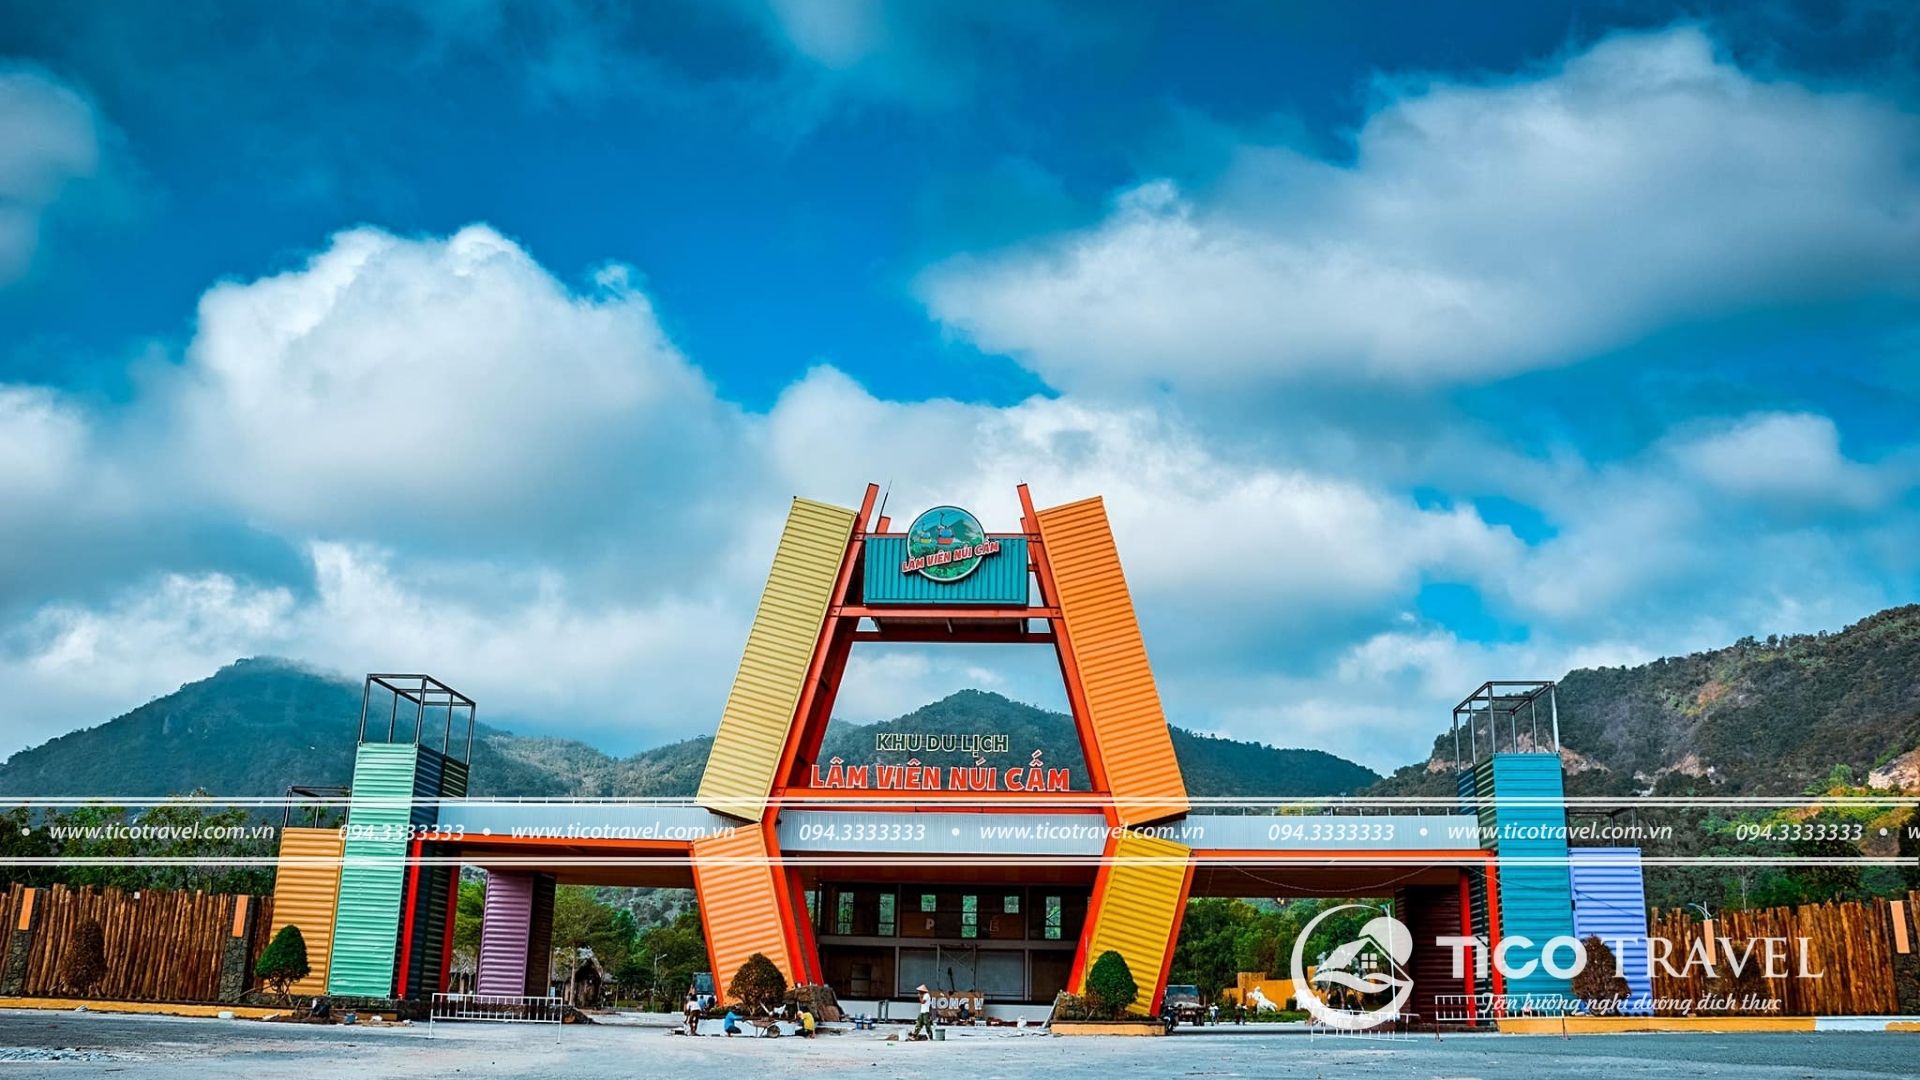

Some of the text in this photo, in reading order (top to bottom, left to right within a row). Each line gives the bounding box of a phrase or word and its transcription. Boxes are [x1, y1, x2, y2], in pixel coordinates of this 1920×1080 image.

[876, 733, 1009, 757] KHU DU LỊCH
[810, 750, 1069, 792] LÂM VIÊN NÚI CẤM
